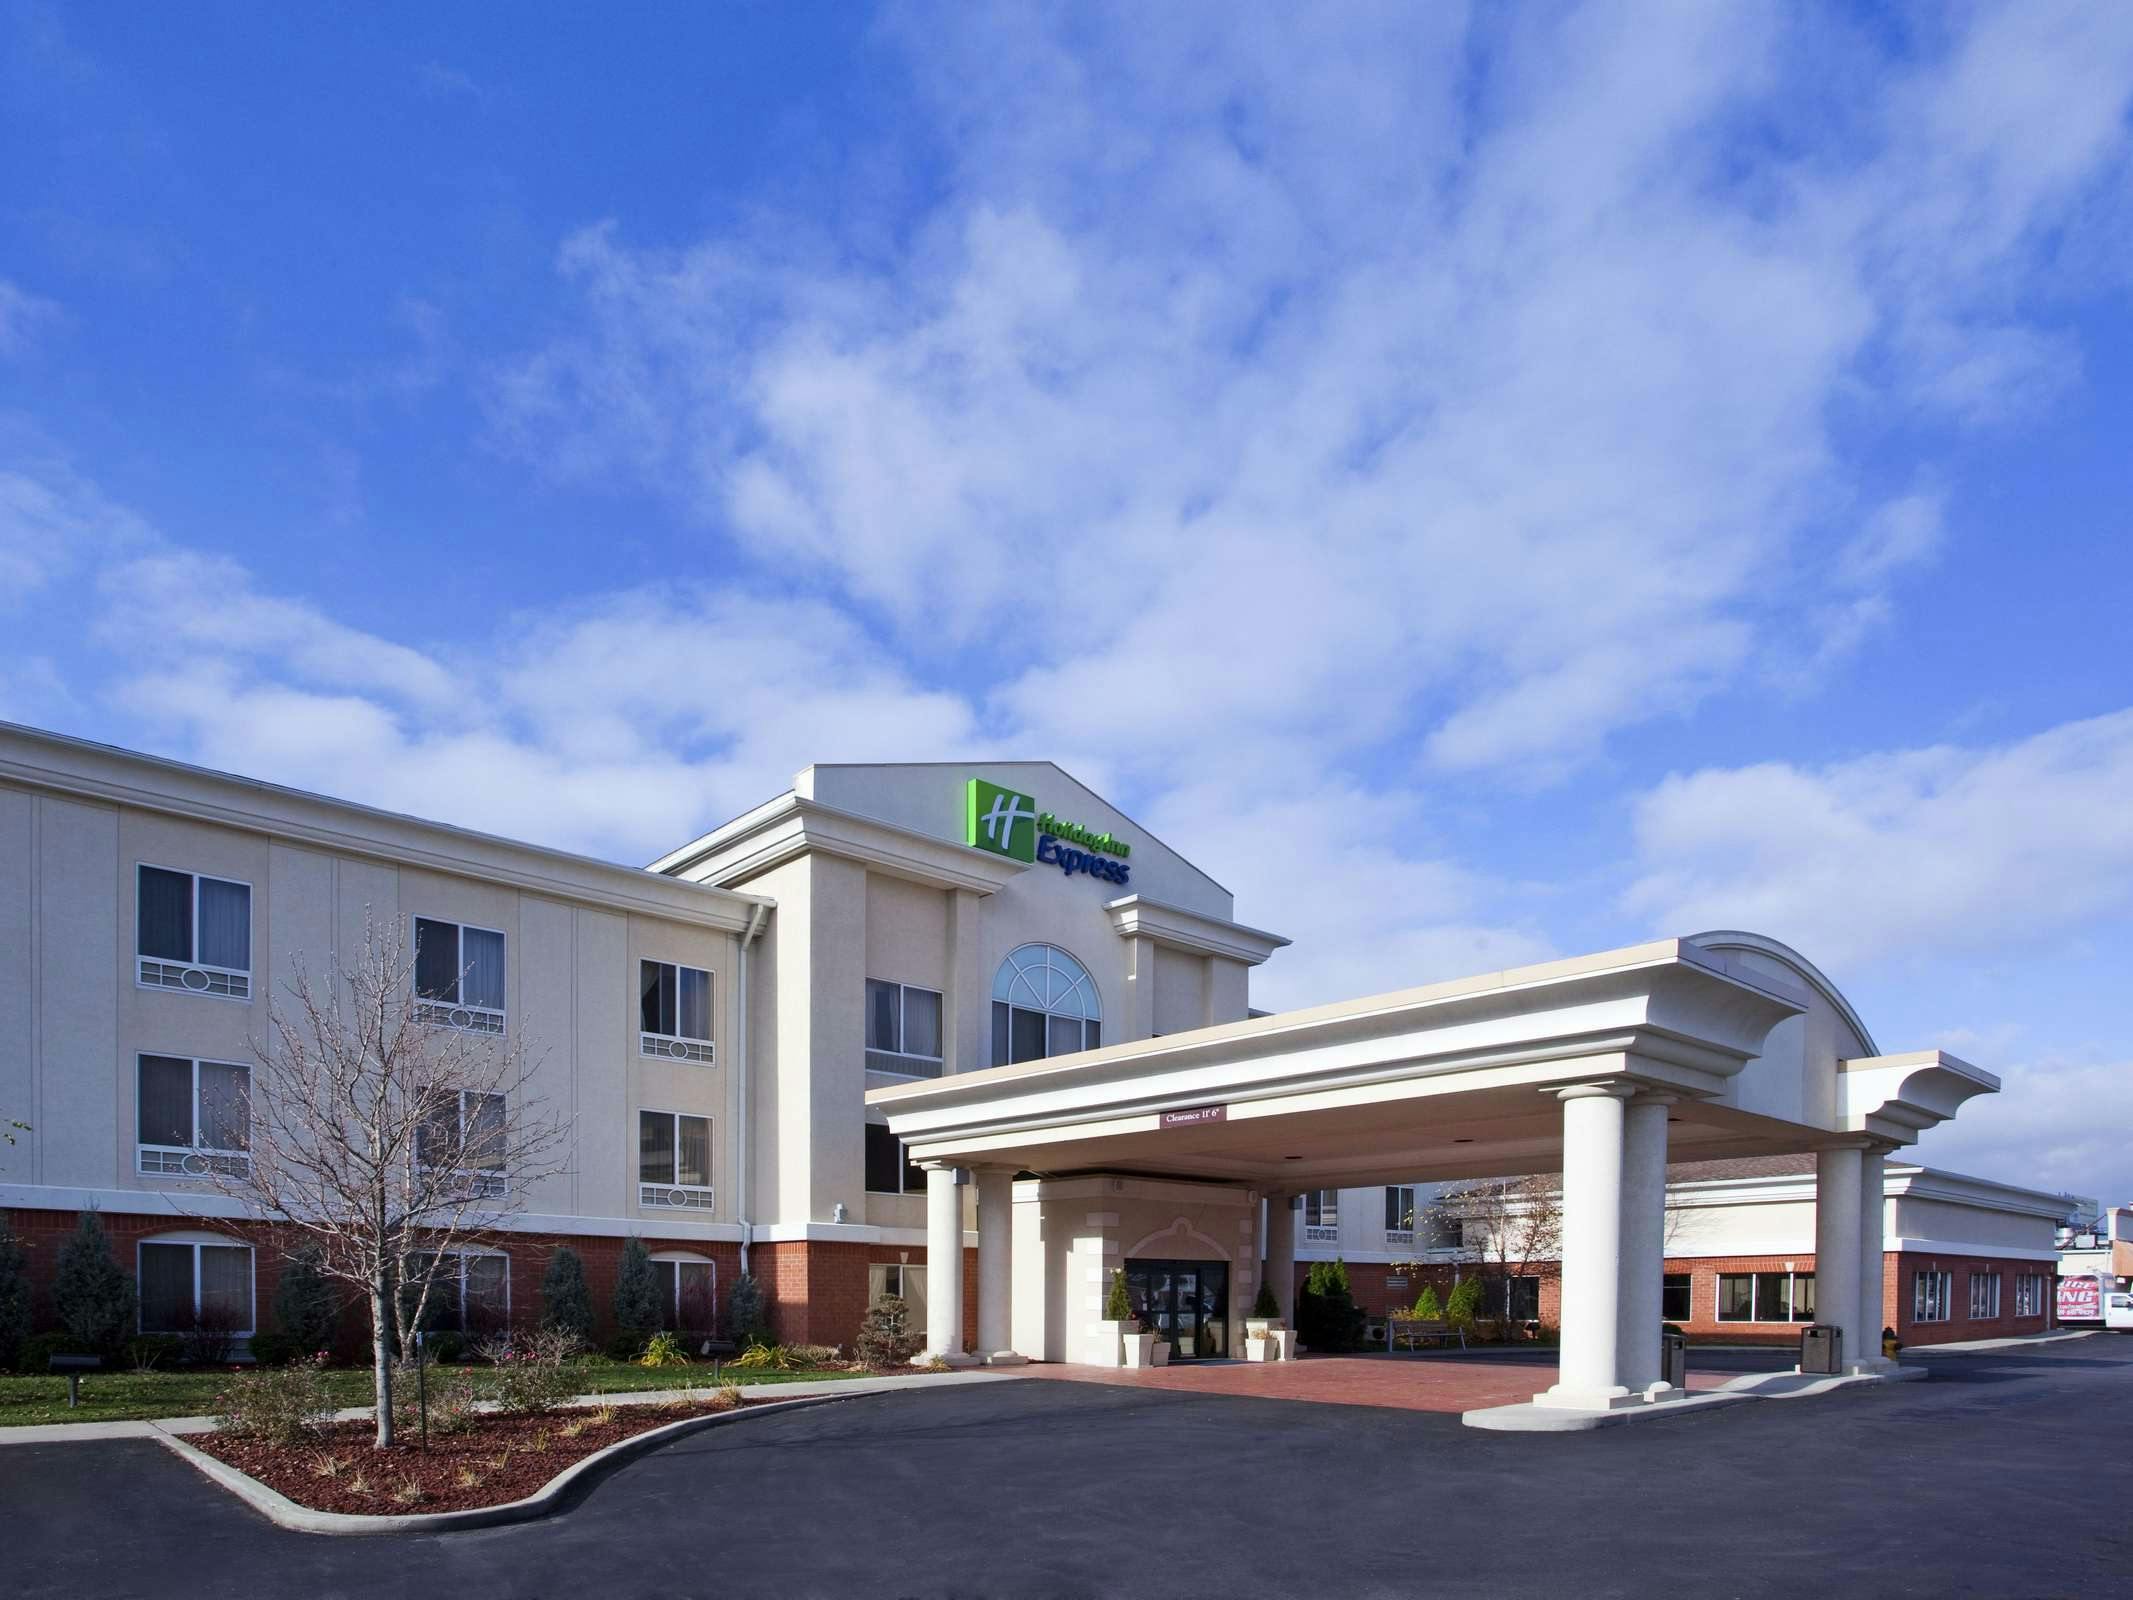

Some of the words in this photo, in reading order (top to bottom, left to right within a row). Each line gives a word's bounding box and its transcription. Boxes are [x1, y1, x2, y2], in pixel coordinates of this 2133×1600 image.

[1037, 812, 1104, 853] Holiday
[1102, 832, 1131, 858] Inn
[1037, 835, 1130, 885] Express
[1166, 1112, 1200, 1122] Clearance
